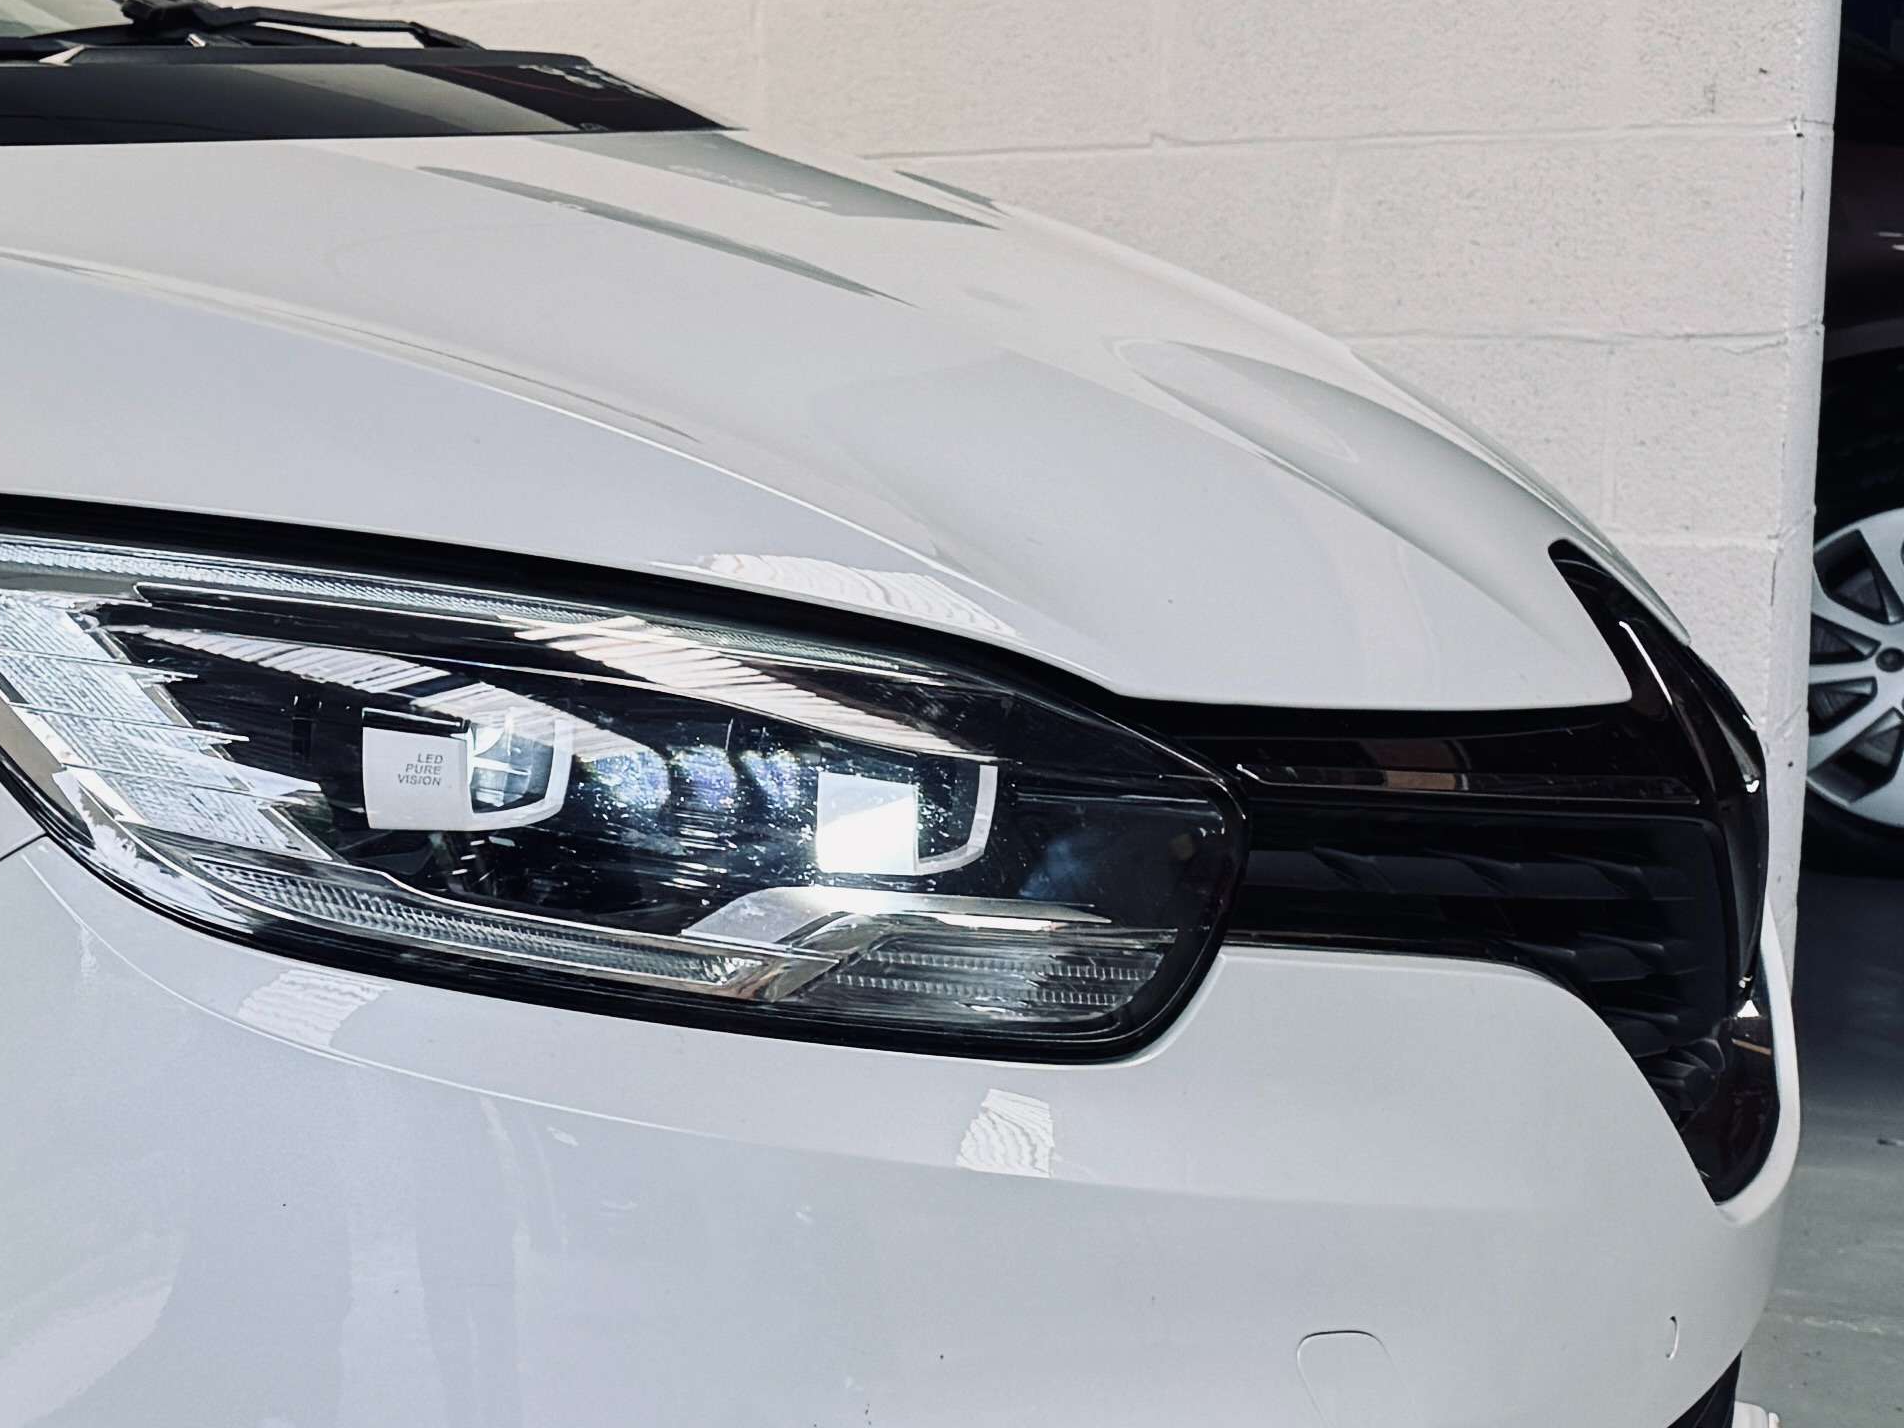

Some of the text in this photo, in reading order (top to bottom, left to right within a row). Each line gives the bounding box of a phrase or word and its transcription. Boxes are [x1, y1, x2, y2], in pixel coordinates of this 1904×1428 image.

[417, 753, 443, 764] LED
[405, 763, 443, 776] PURE
[397, 773, 441, 786] VISION
